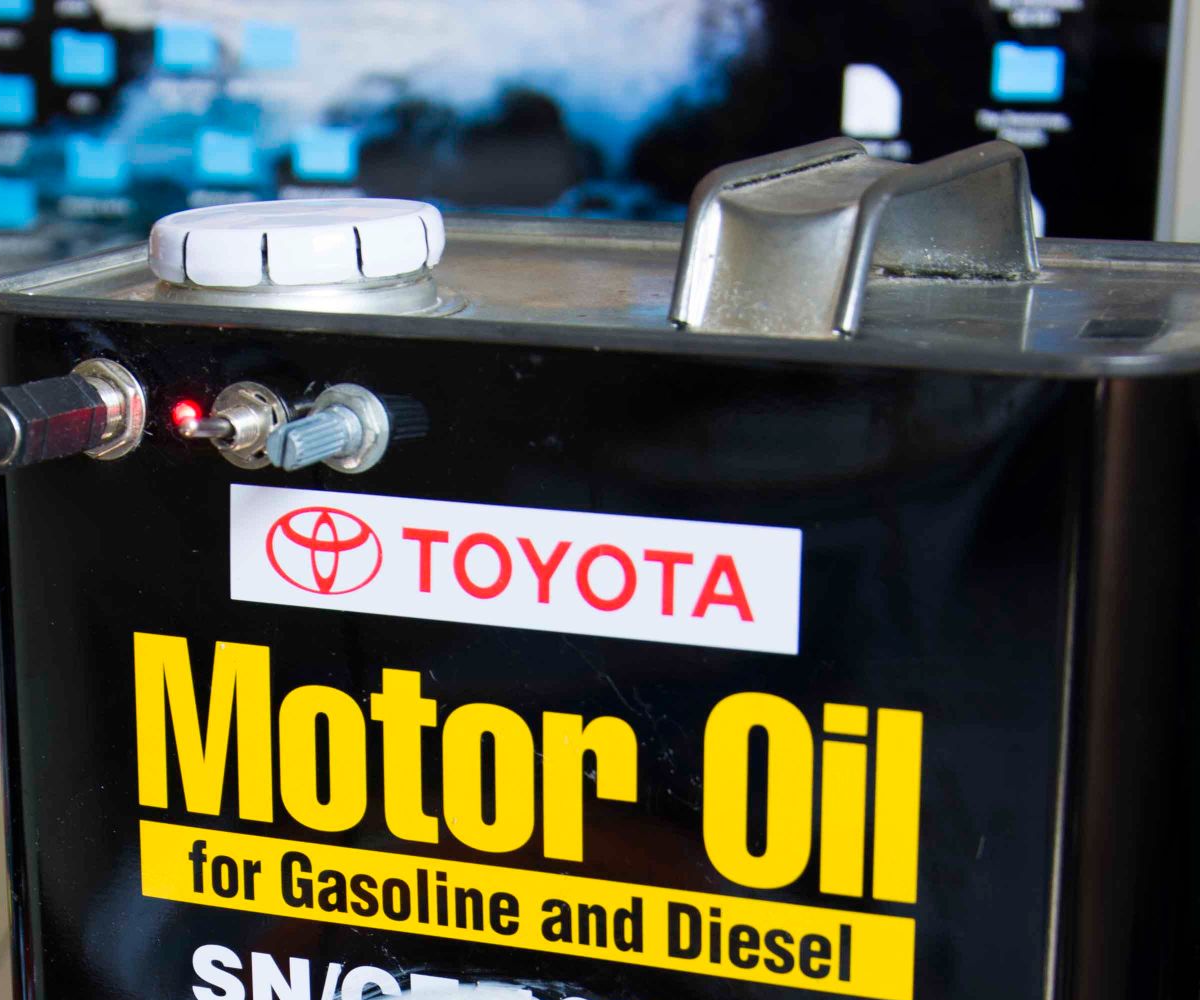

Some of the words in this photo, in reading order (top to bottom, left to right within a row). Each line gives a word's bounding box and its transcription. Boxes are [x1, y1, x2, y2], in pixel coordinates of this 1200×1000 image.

[402, 527, 754, 622] TOYOTA
[133, 631, 638, 862] Motor
[703, 691, 923, 904] Oil
[189, 840, 261, 902] for
[281, 850, 520, 937] Gasoline
[541, 896, 643, 953] and
[668, 908, 852, 982] Diesel
